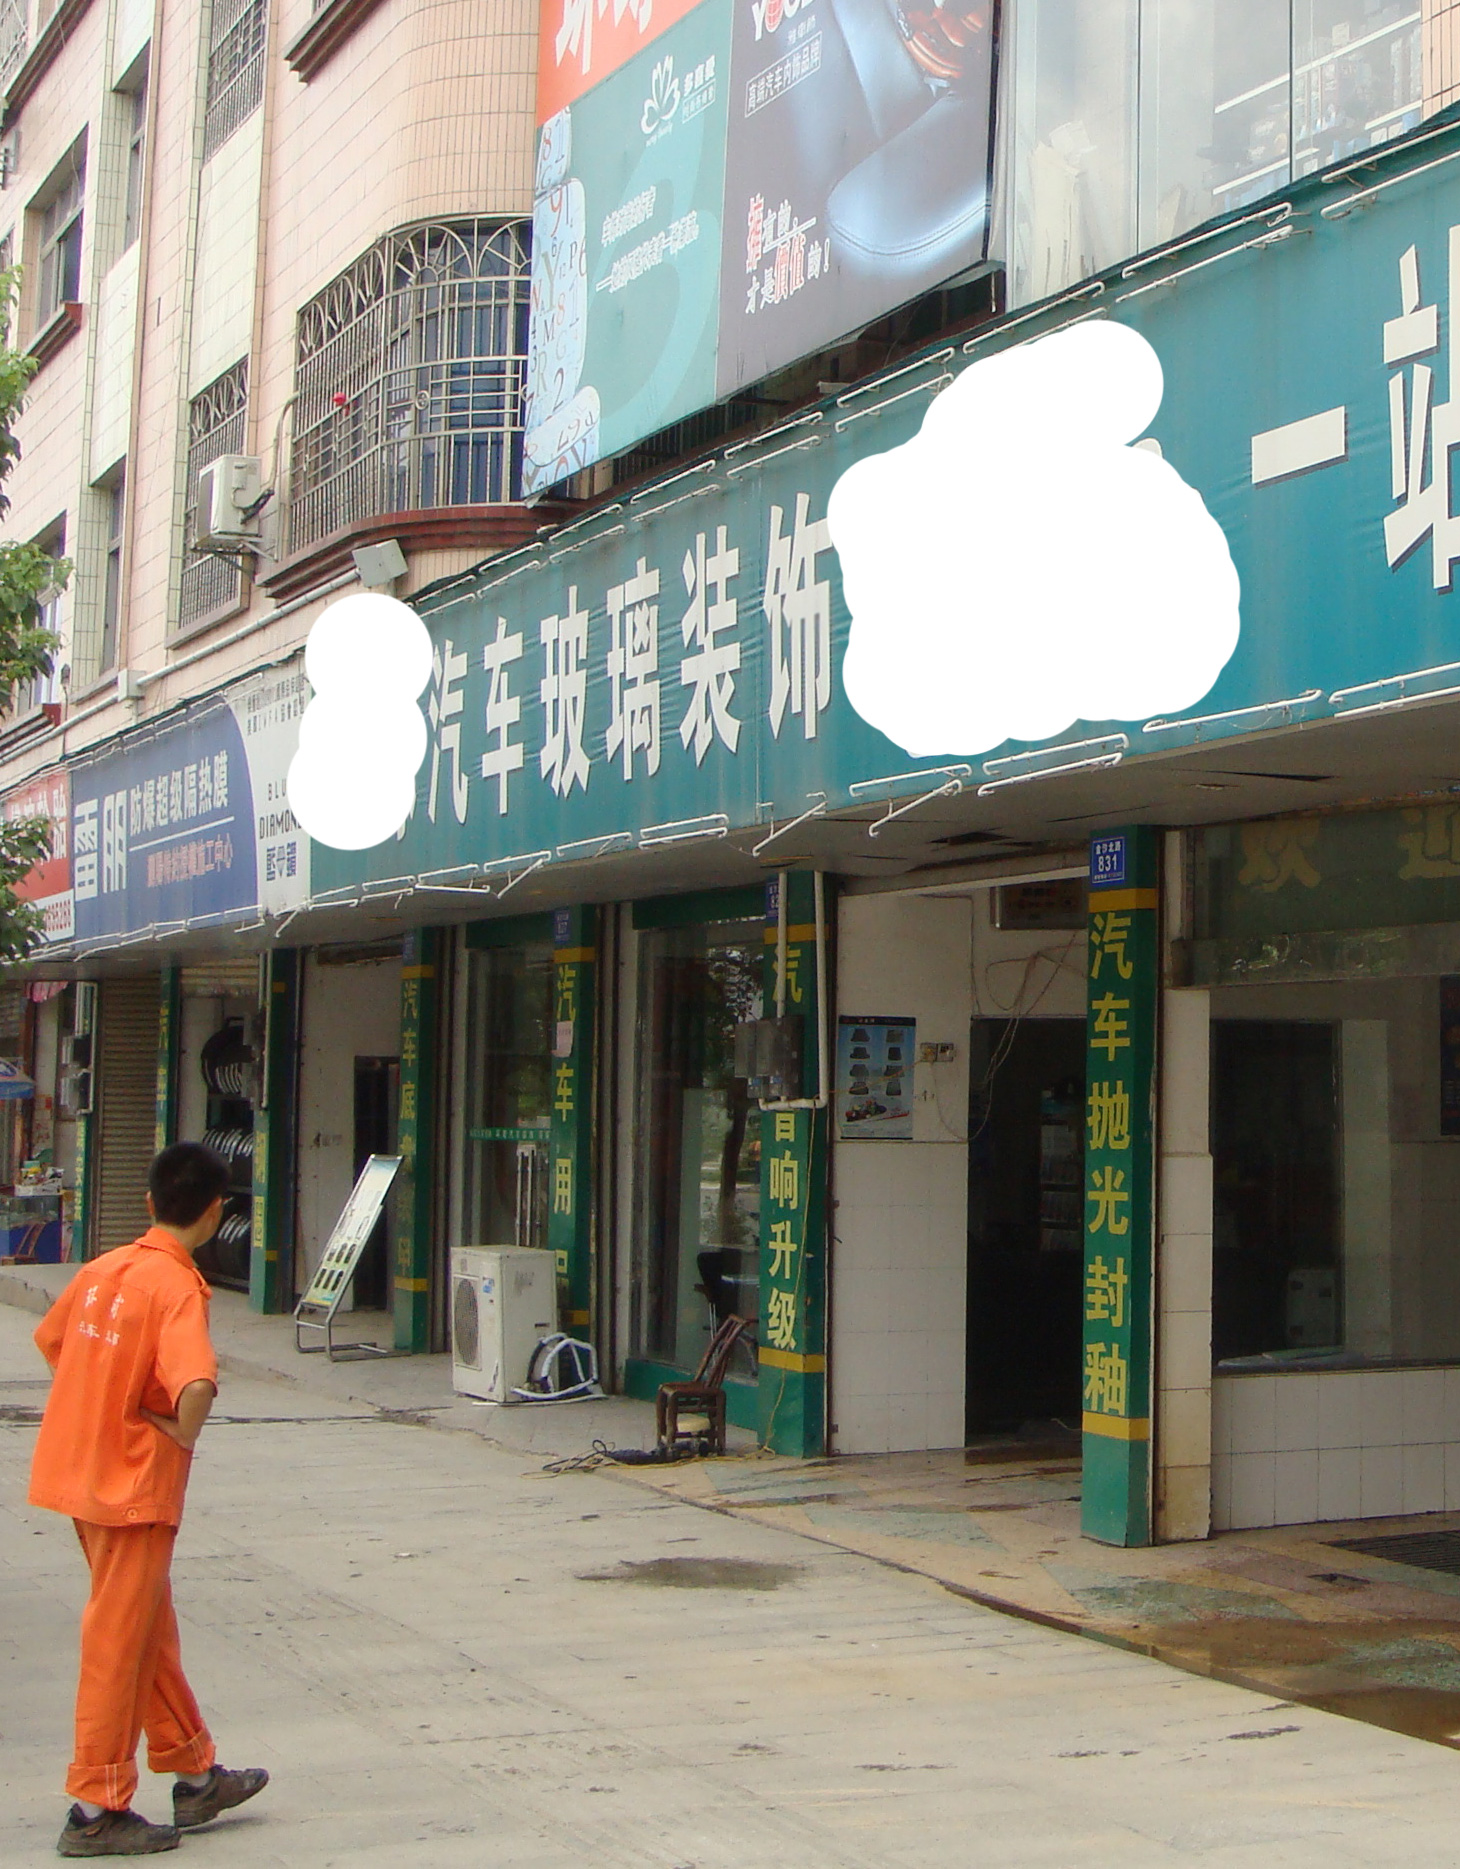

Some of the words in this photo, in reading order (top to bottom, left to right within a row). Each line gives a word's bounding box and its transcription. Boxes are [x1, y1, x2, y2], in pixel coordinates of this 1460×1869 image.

[427, 492, 833, 824] 汽车玻璃装饰
[130, 750, 229, 837] 防爆超级隔热膜
[259, 808, 302, 840] DIAMON
[75, 789, 127, 902] 雷朋
[1098, 853, 1117, 872] 831
[1084, 911, 1133, 1417] 汽车抛光封釉
